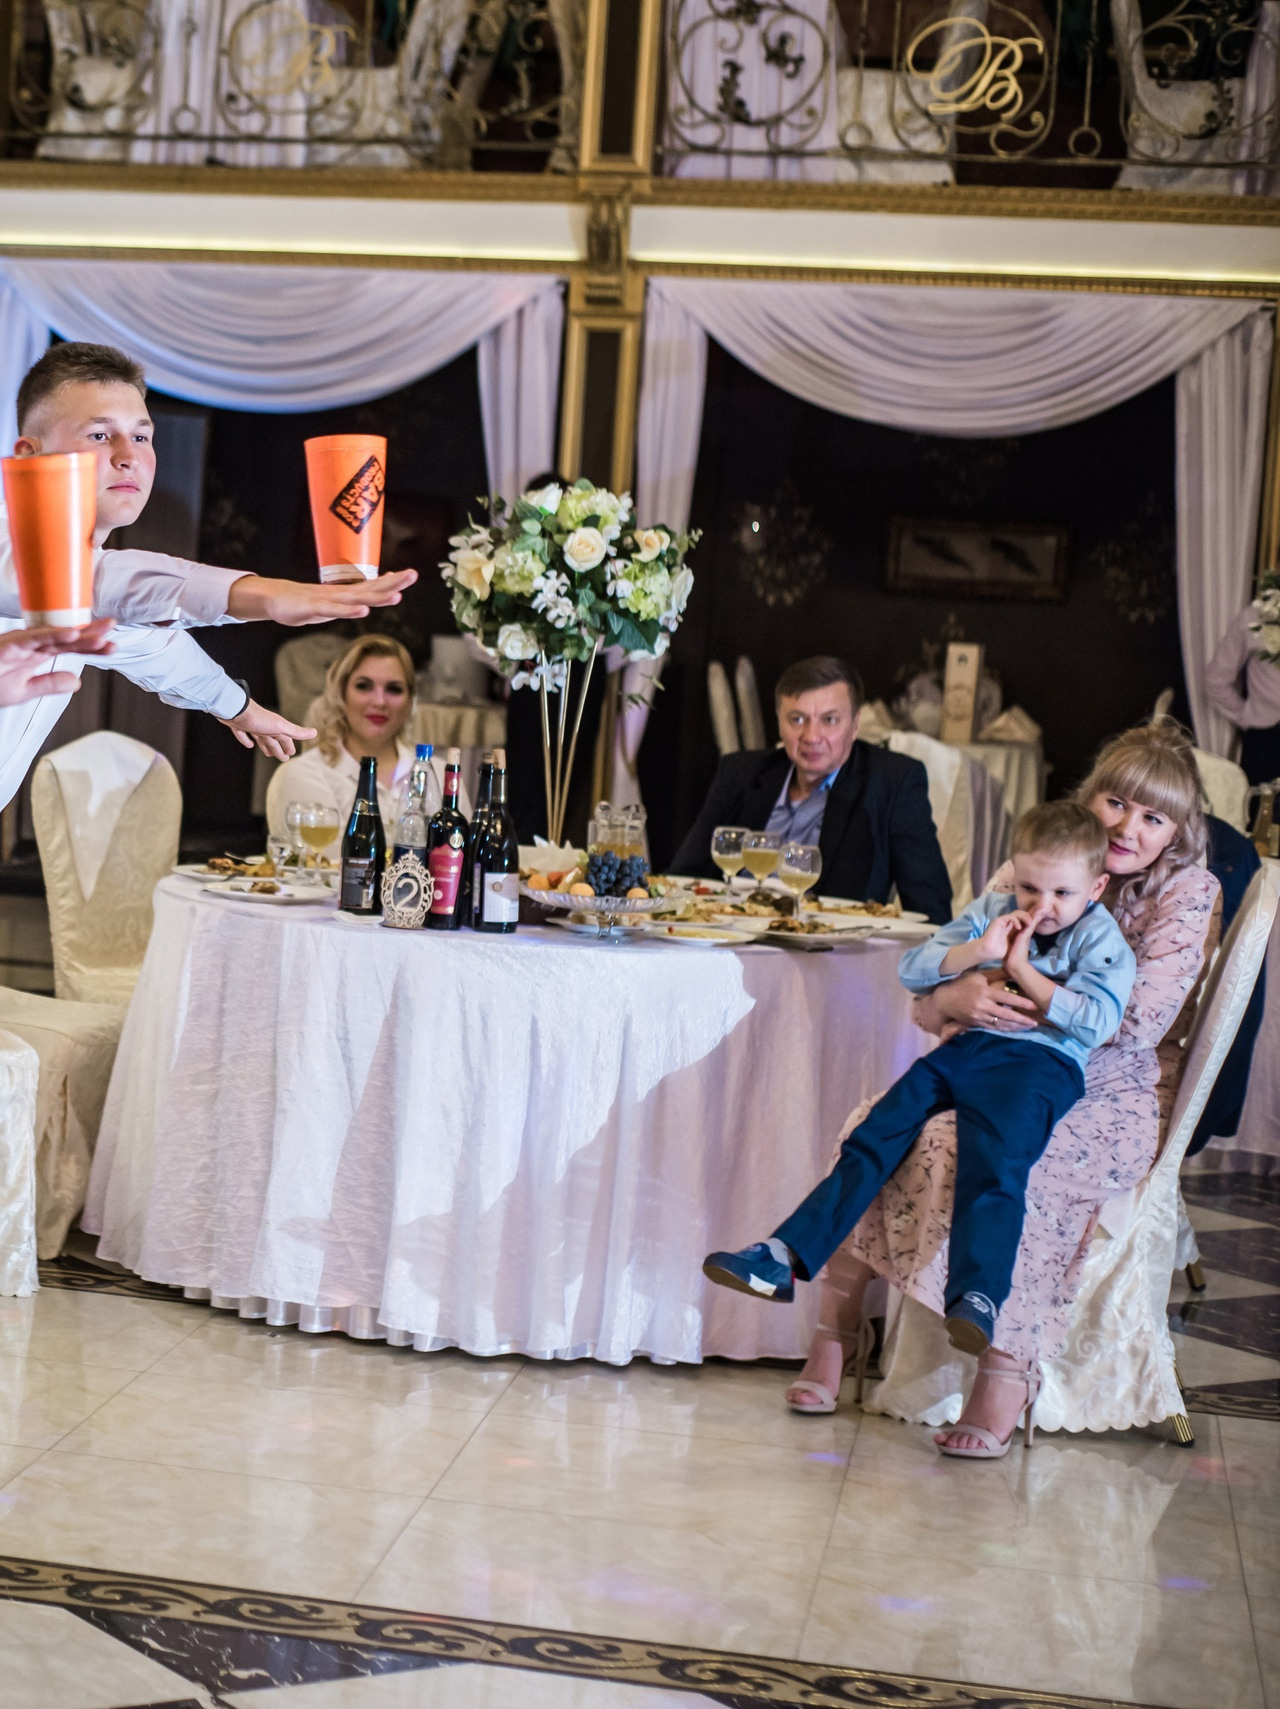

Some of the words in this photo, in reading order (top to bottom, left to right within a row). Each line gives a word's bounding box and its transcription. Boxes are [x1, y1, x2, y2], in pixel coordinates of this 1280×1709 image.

[340, 460, 381, 509] PRODUCTS
[348, 468, 386, 520] BAR
[395, 877, 419, 911] 2
